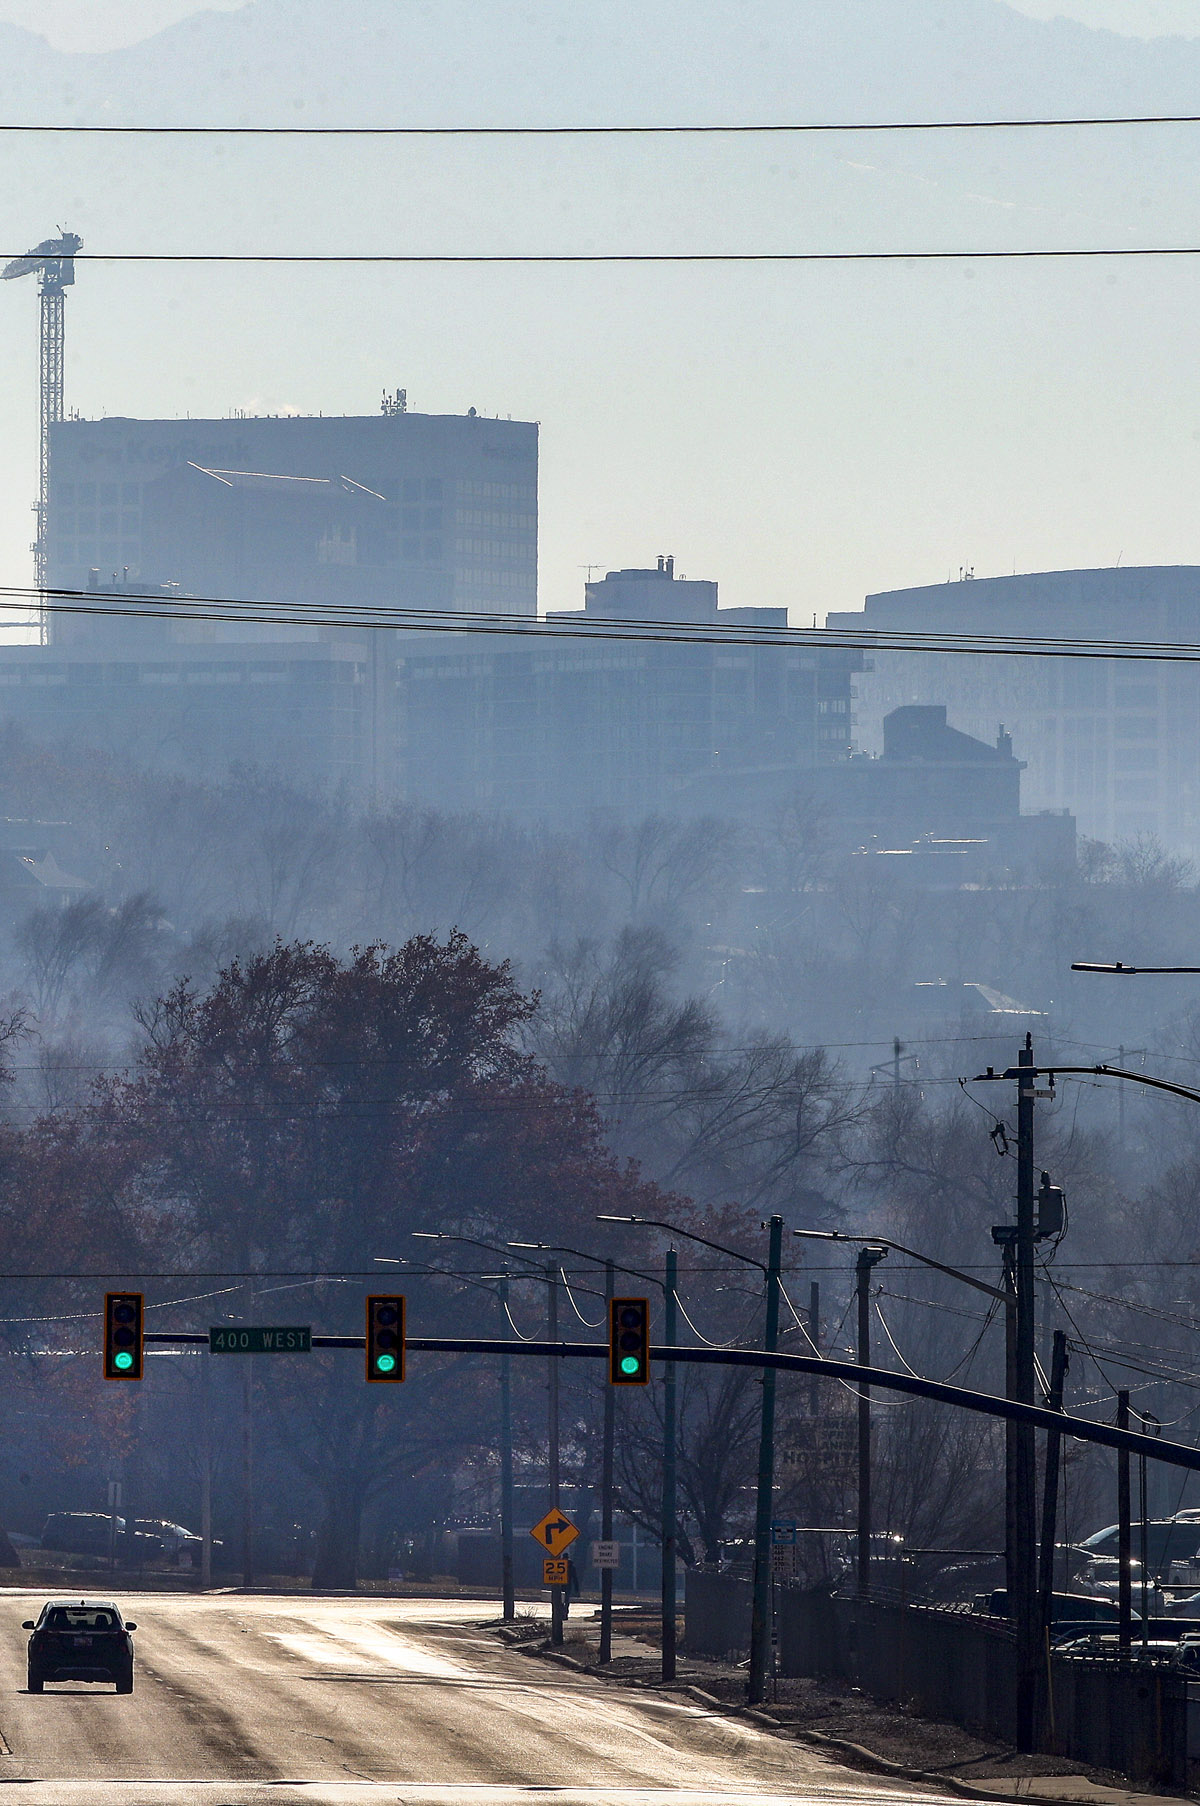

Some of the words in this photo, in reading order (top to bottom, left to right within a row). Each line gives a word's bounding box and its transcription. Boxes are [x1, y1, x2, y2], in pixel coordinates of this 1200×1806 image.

[127, 438, 253, 468] KeyBank
[216, 1332, 249, 1348] 400
[263, 1332, 306, 1348] WEST
[783, 1451, 859, 1465] HOSPITA
[545, 1562, 566, 1574] 25
